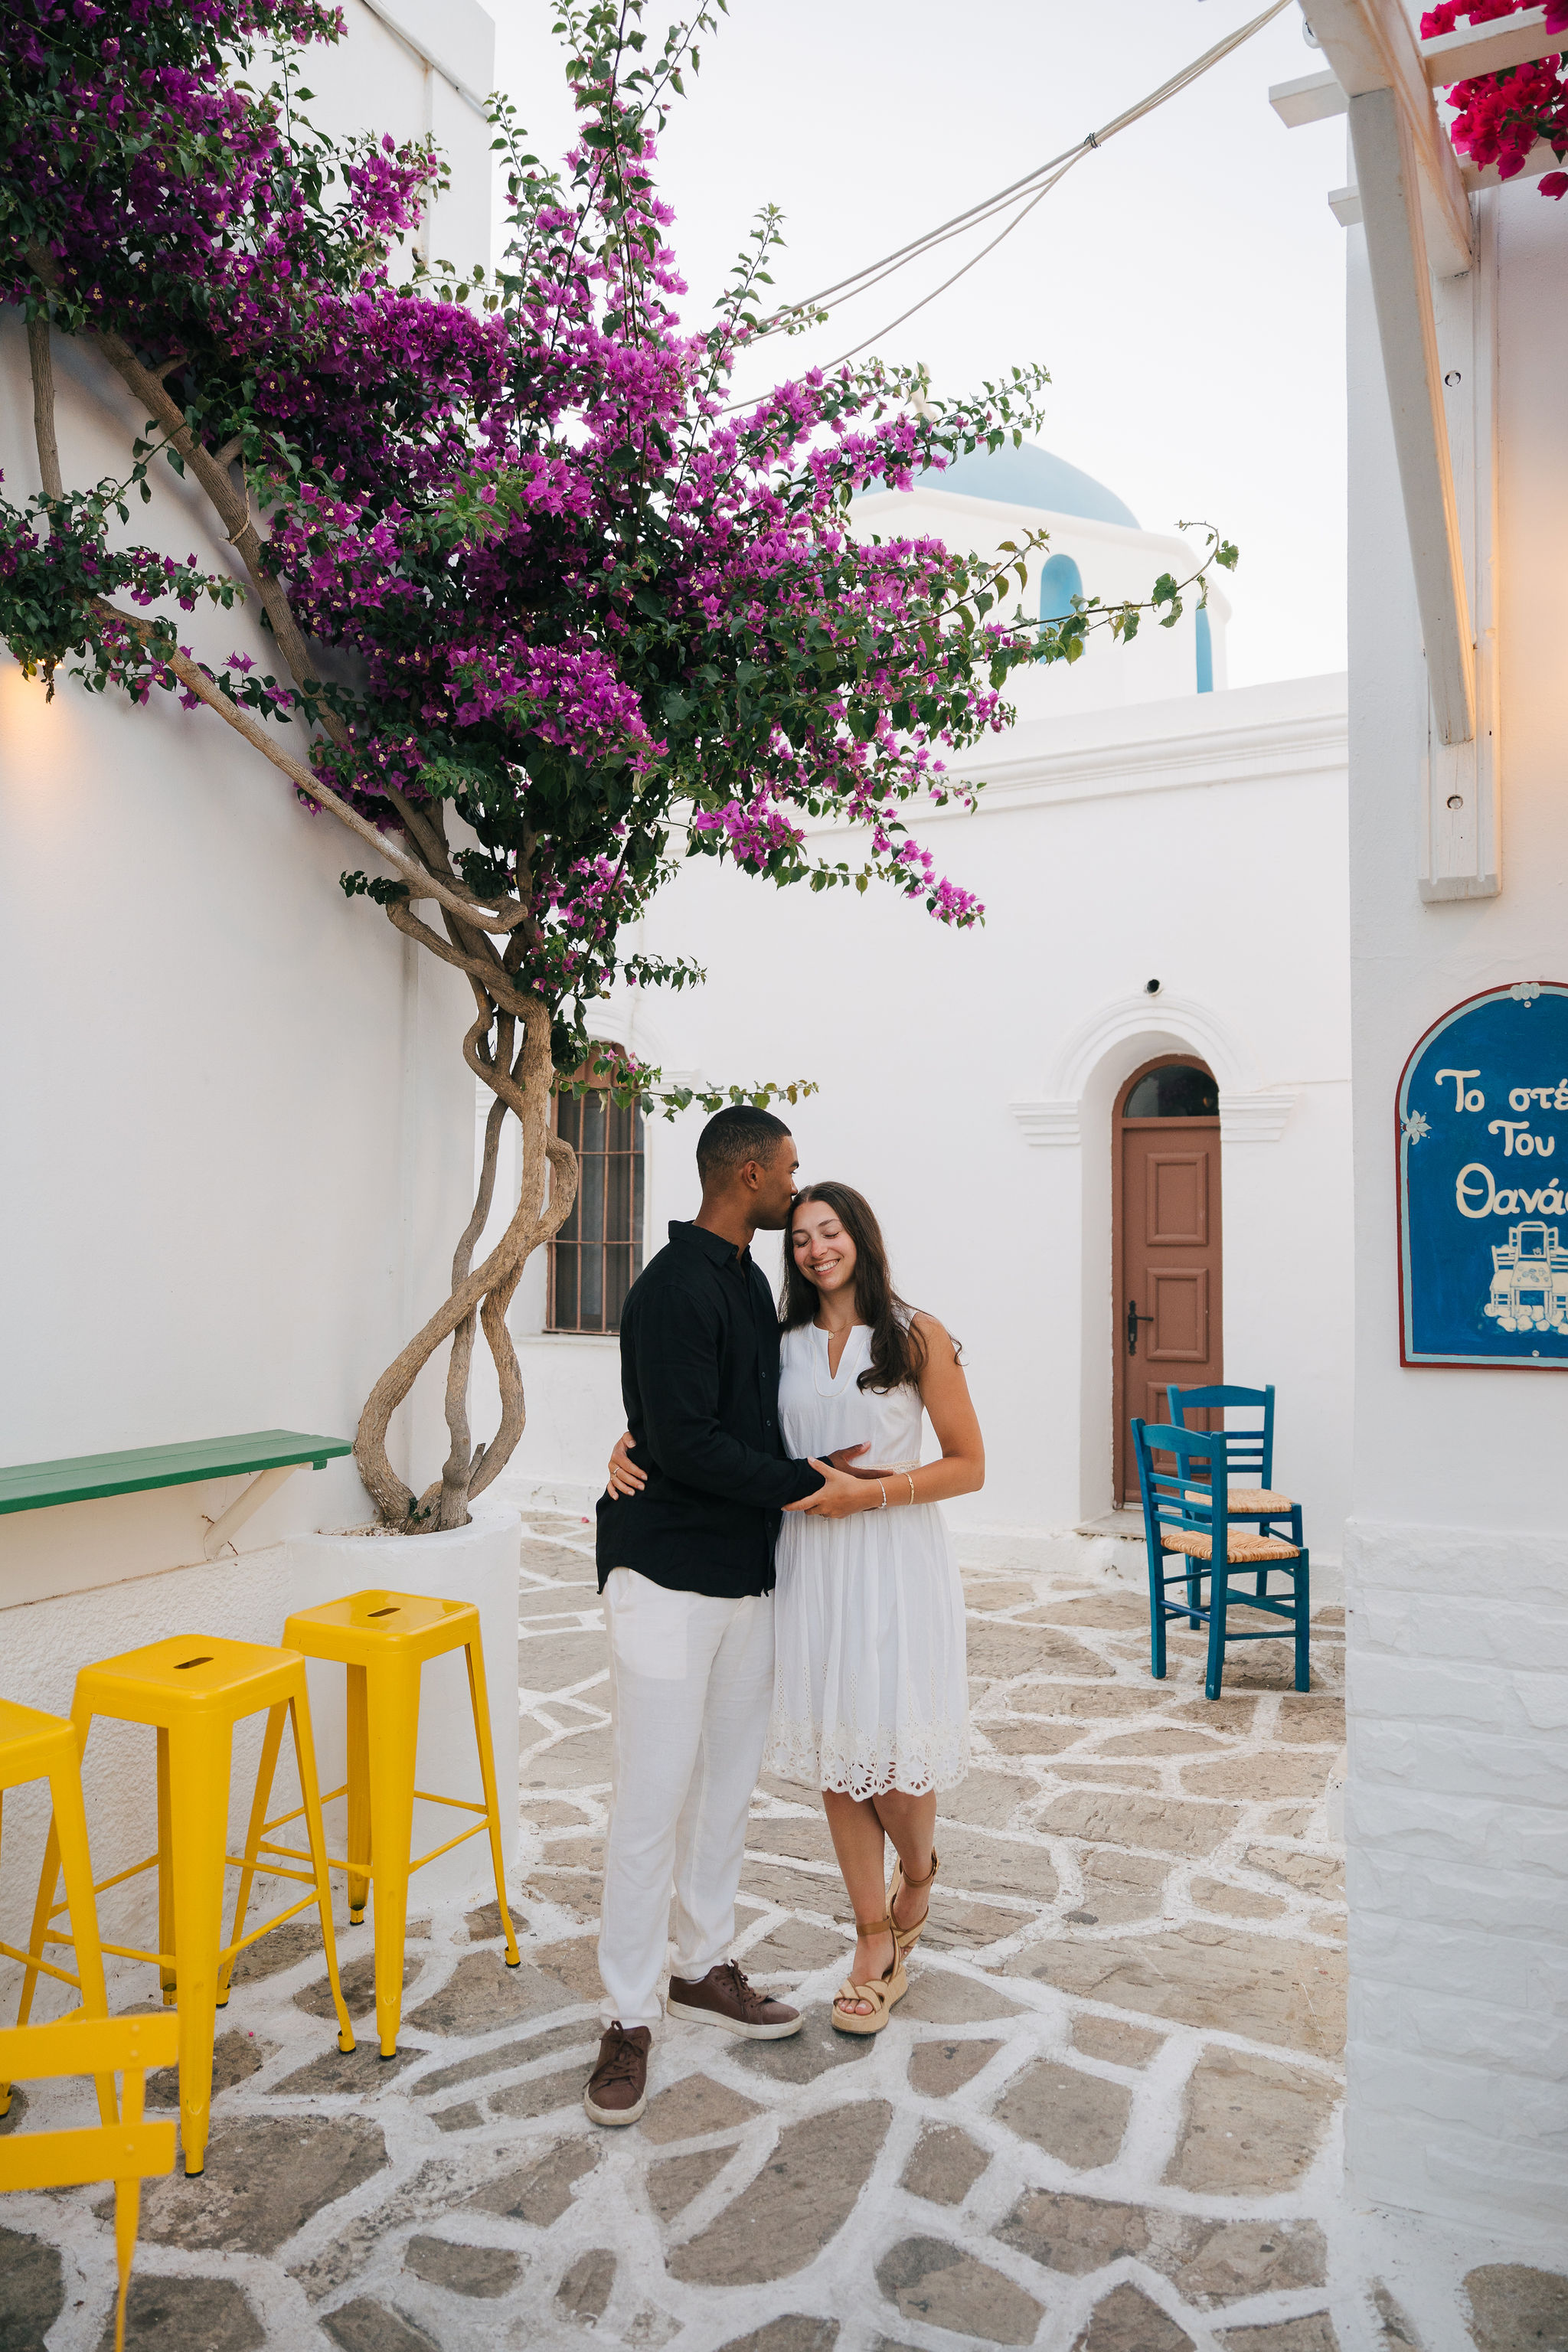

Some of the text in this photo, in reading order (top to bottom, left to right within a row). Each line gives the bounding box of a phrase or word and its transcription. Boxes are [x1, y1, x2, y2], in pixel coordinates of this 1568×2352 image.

[1434, 1069, 1485, 1112] Το
[1488, 1120, 1556, 1157] Του
[1455, 1162, 1568, 1219] Θανά
